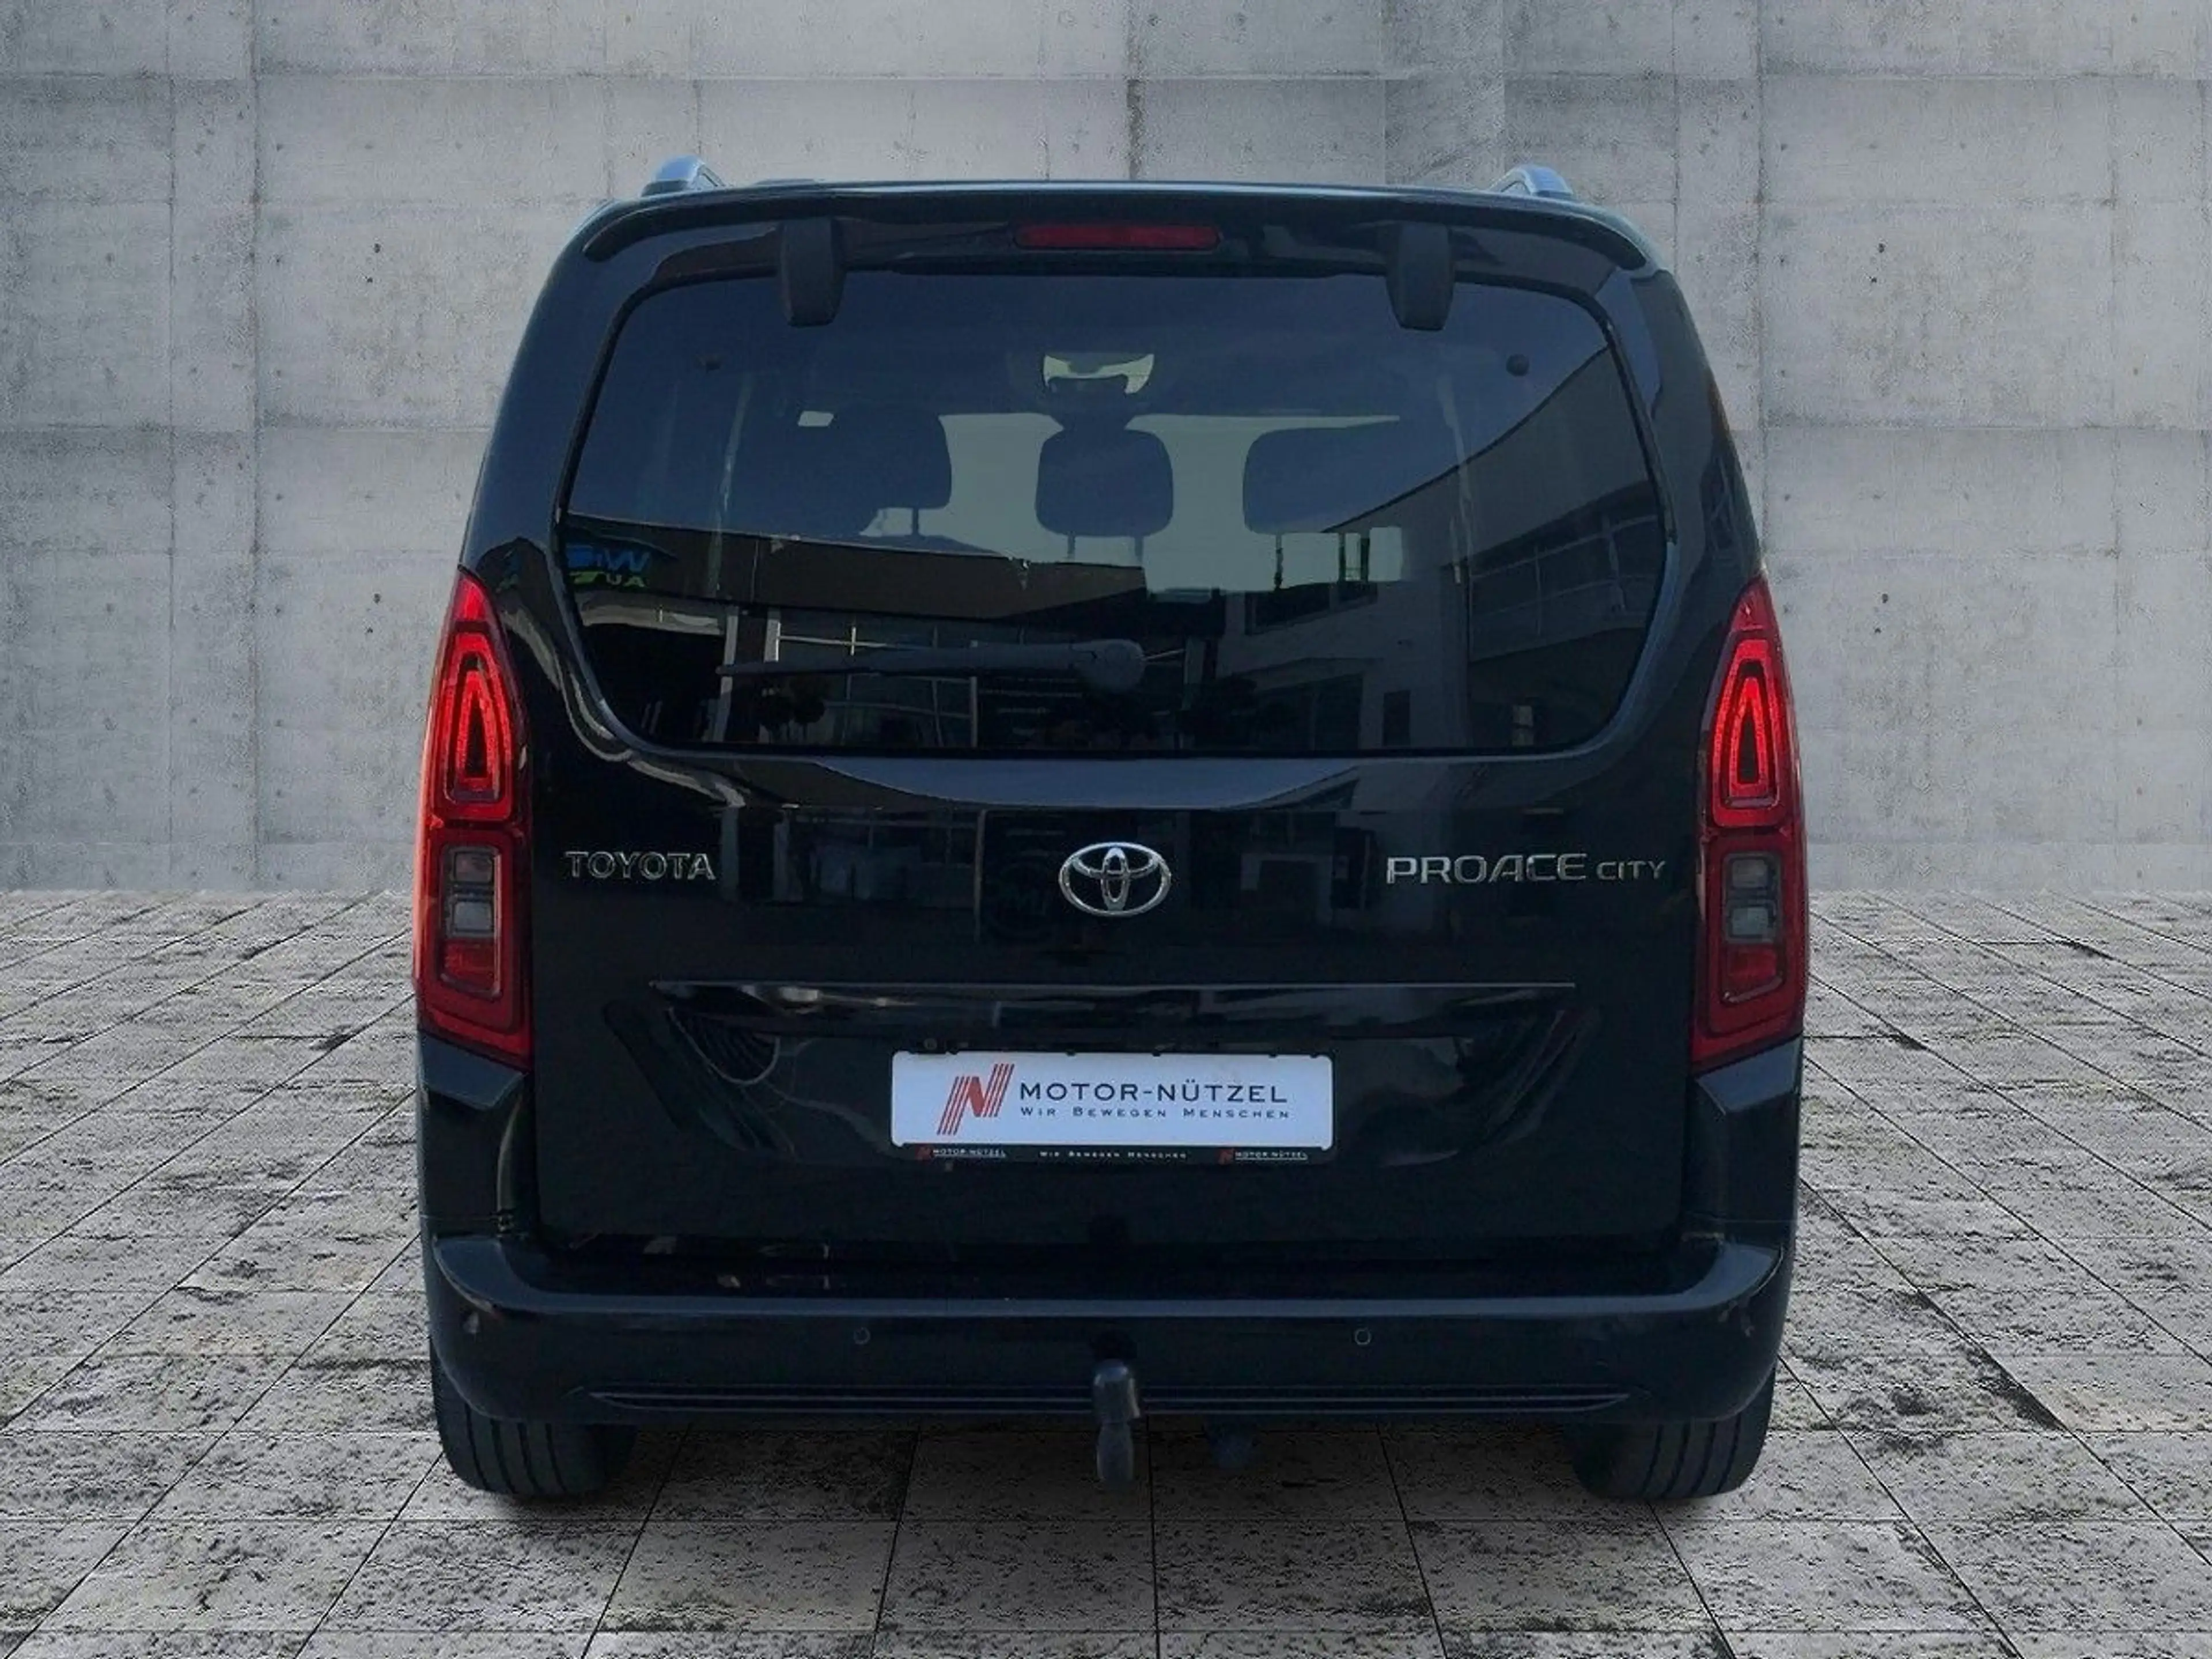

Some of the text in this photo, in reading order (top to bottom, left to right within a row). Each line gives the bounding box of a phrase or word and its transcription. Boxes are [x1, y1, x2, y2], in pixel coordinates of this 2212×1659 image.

[564, 850, 717, 880] TOYOTA
[1385, 853, 1666, 884] PROACE CITY
[1019, 1078, 1288, 1103] MOTOR-NÜTZEL
